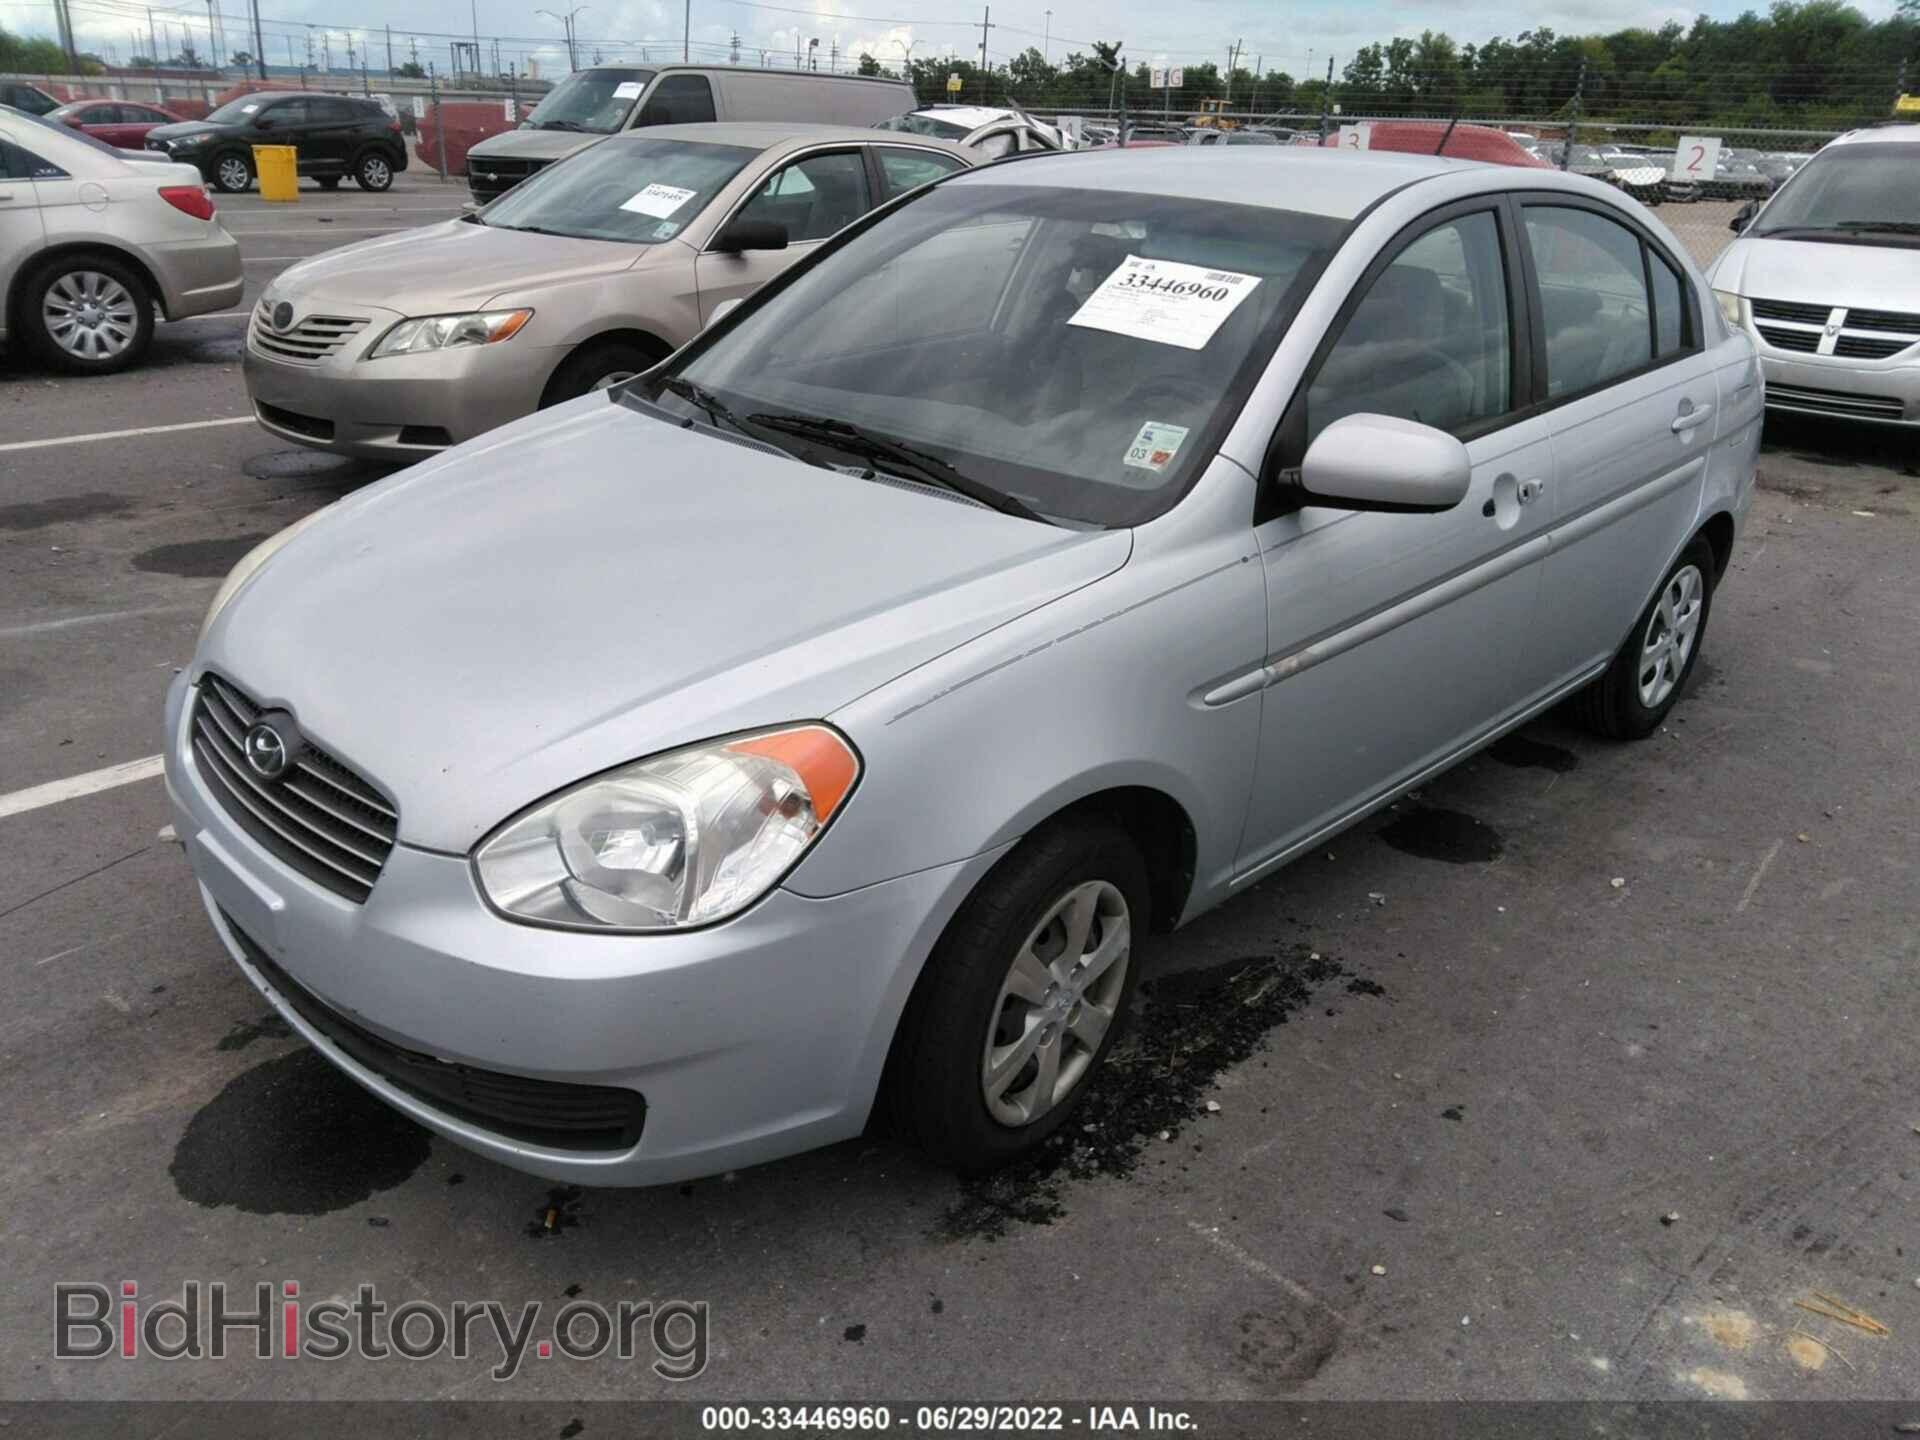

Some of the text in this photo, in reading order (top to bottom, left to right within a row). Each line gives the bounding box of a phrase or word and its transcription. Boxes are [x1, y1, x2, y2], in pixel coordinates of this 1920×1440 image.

[1170, 68, 1182, 86] G
[1686, 144, 1705, 171] 2
[1118, 272, 1229, 302] 33446960
[1130, 446, 1147, 460] 03
